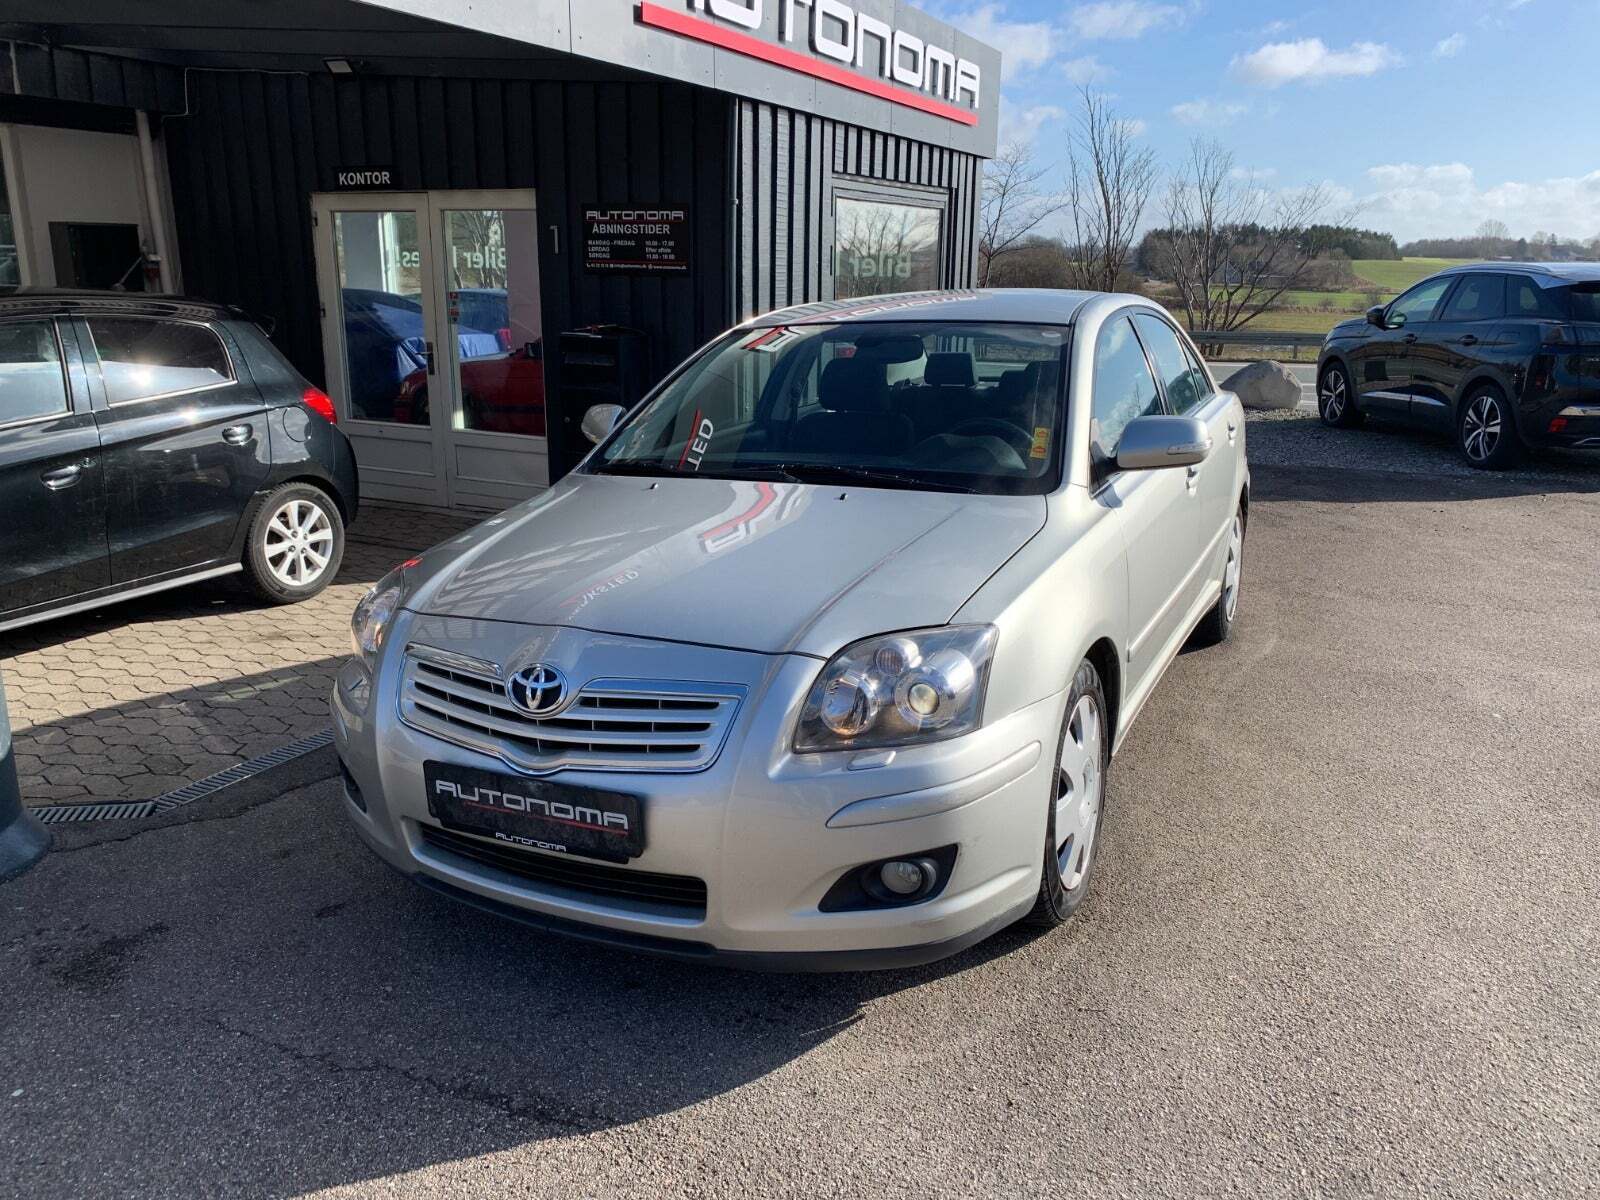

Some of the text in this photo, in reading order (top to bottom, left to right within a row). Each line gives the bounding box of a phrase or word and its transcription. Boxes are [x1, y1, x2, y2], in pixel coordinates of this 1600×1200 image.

[693, 0, 980, 109] TONOMA
[338, 171, 390, 186] KONTOR
[586, 210, 684, 221] AUTONOMA
[435, 779, 629, 830] AUTONOMA
[495, 832, 567, 853] AUTONOMA
